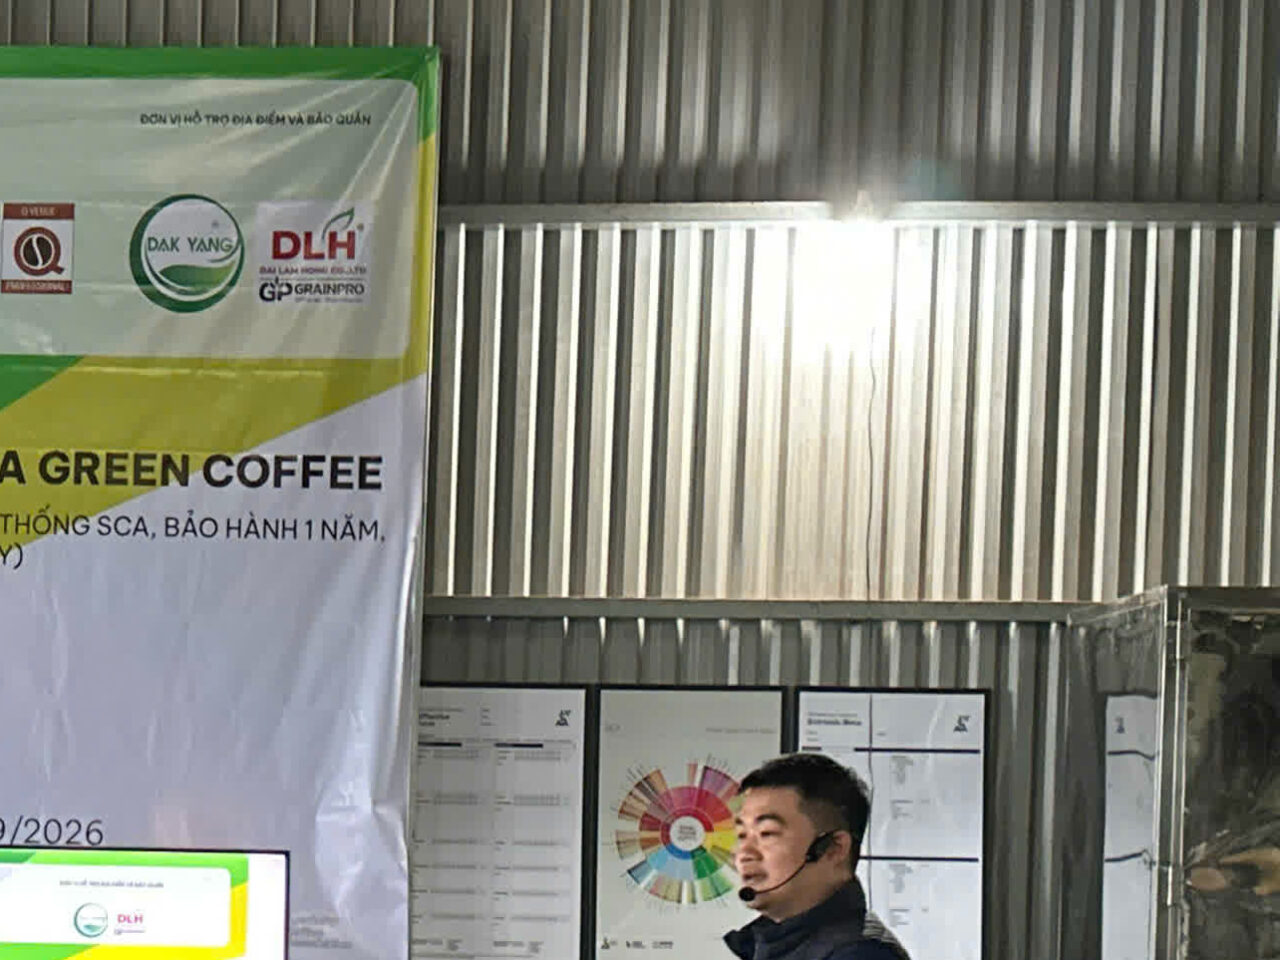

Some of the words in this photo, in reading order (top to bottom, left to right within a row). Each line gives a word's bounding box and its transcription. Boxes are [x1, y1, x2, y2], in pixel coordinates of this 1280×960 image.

[140, 112, 167, 125] ĐƠN
[148, 237, 180, 252] DAK
[188, 237, 234, 252] YANG
[272, 231, 355, 260] DLH
[295, 283, 365, 295] GRAINPRO
[39, 450, 189, 487] GREEN
[203, 453, 382, 490] COFFEE
[0, 505, 90, 536] THỐNG
[98, 516, 156, 540] SCA,
[165, 509, 218, 538] BẢO
[226, 511, 297, 540] HÀNH
[305, 519, 312, 540] 1
[321, 513, 386, 543] NĂM,
